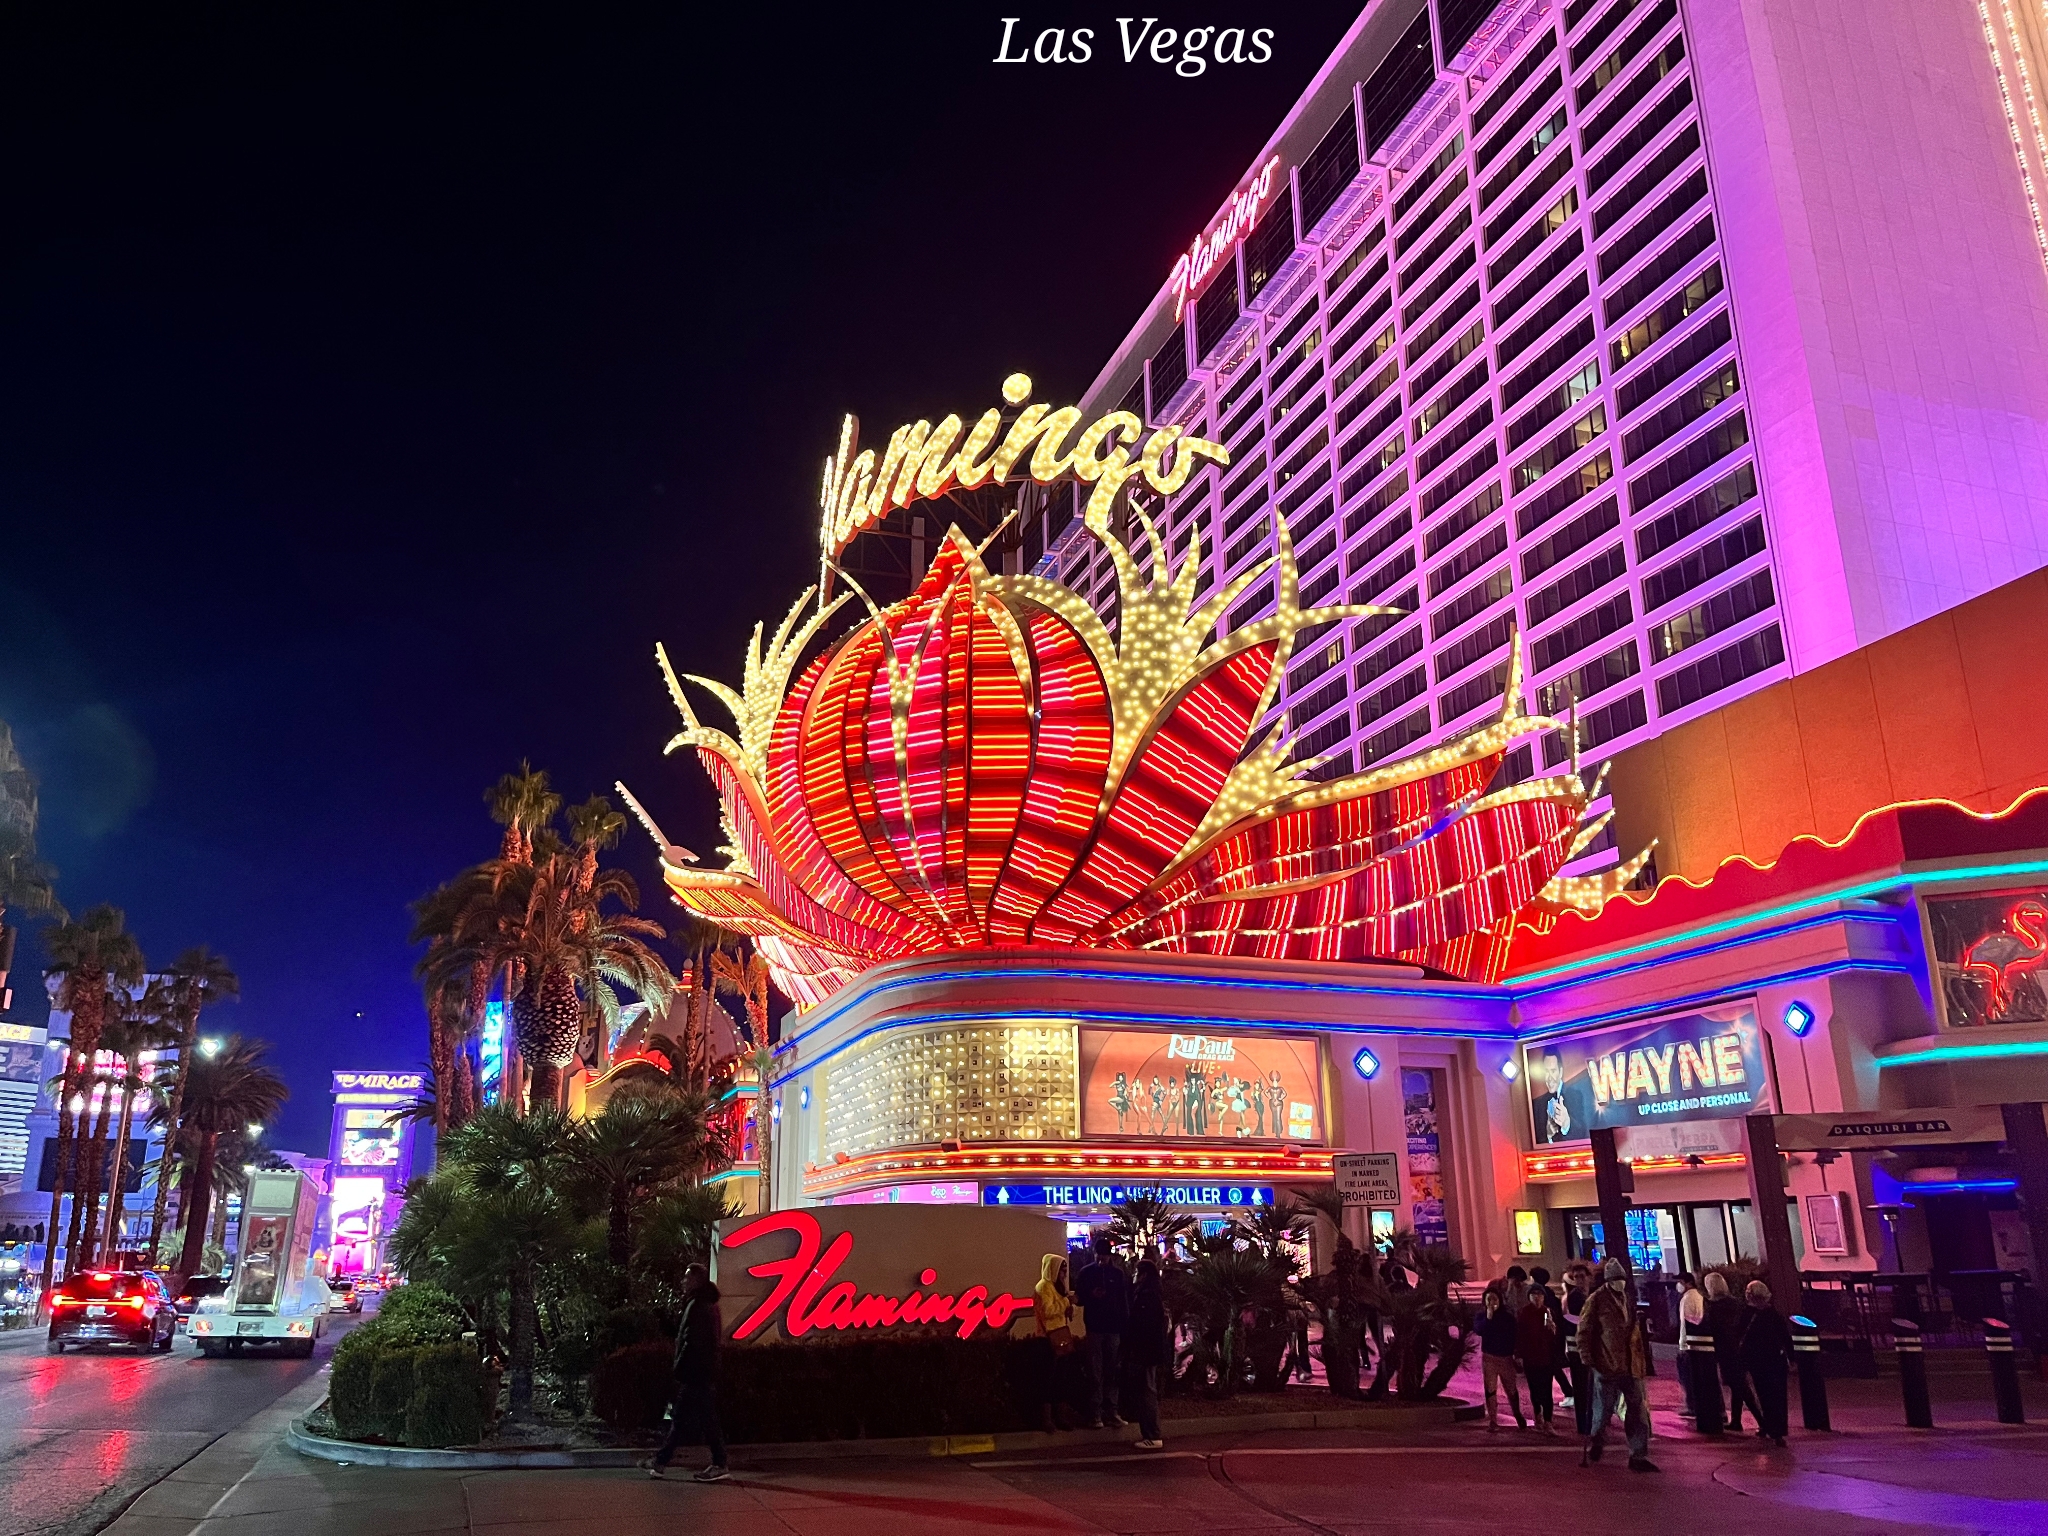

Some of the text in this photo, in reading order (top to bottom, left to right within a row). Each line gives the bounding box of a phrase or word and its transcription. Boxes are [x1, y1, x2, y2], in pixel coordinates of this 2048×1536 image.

[1170, 154, 1280, 322] Flamingo
[1191, 1060, 1216, 1074] LIVE
[1585, 1033, 1746, 1105] WAYNE
[356, 1074, 422, 1090] MIRAGE
[1637, 1091, 1752, 1116] UP CLOSE AND PERSONAL
[1834, 1122, 1946, 1135] DAIQUIRI BAR
[1340, 1158, 1390, 1168] ON-STREET PARKING
[1358, 1169, 1379, 1177] MARKED
[1371, 1179, 1388, 1187] AREAS
[1043, 1186, 1074, 1203] THE
[1078, 1186, 1112, 1204] LINQ
[1165, 1186, 1221, 1204] ROLLER
[1338, 1189, 1397, 1202] PROHIBITED
[720, 1209, 1034, 1340] Flamingo
